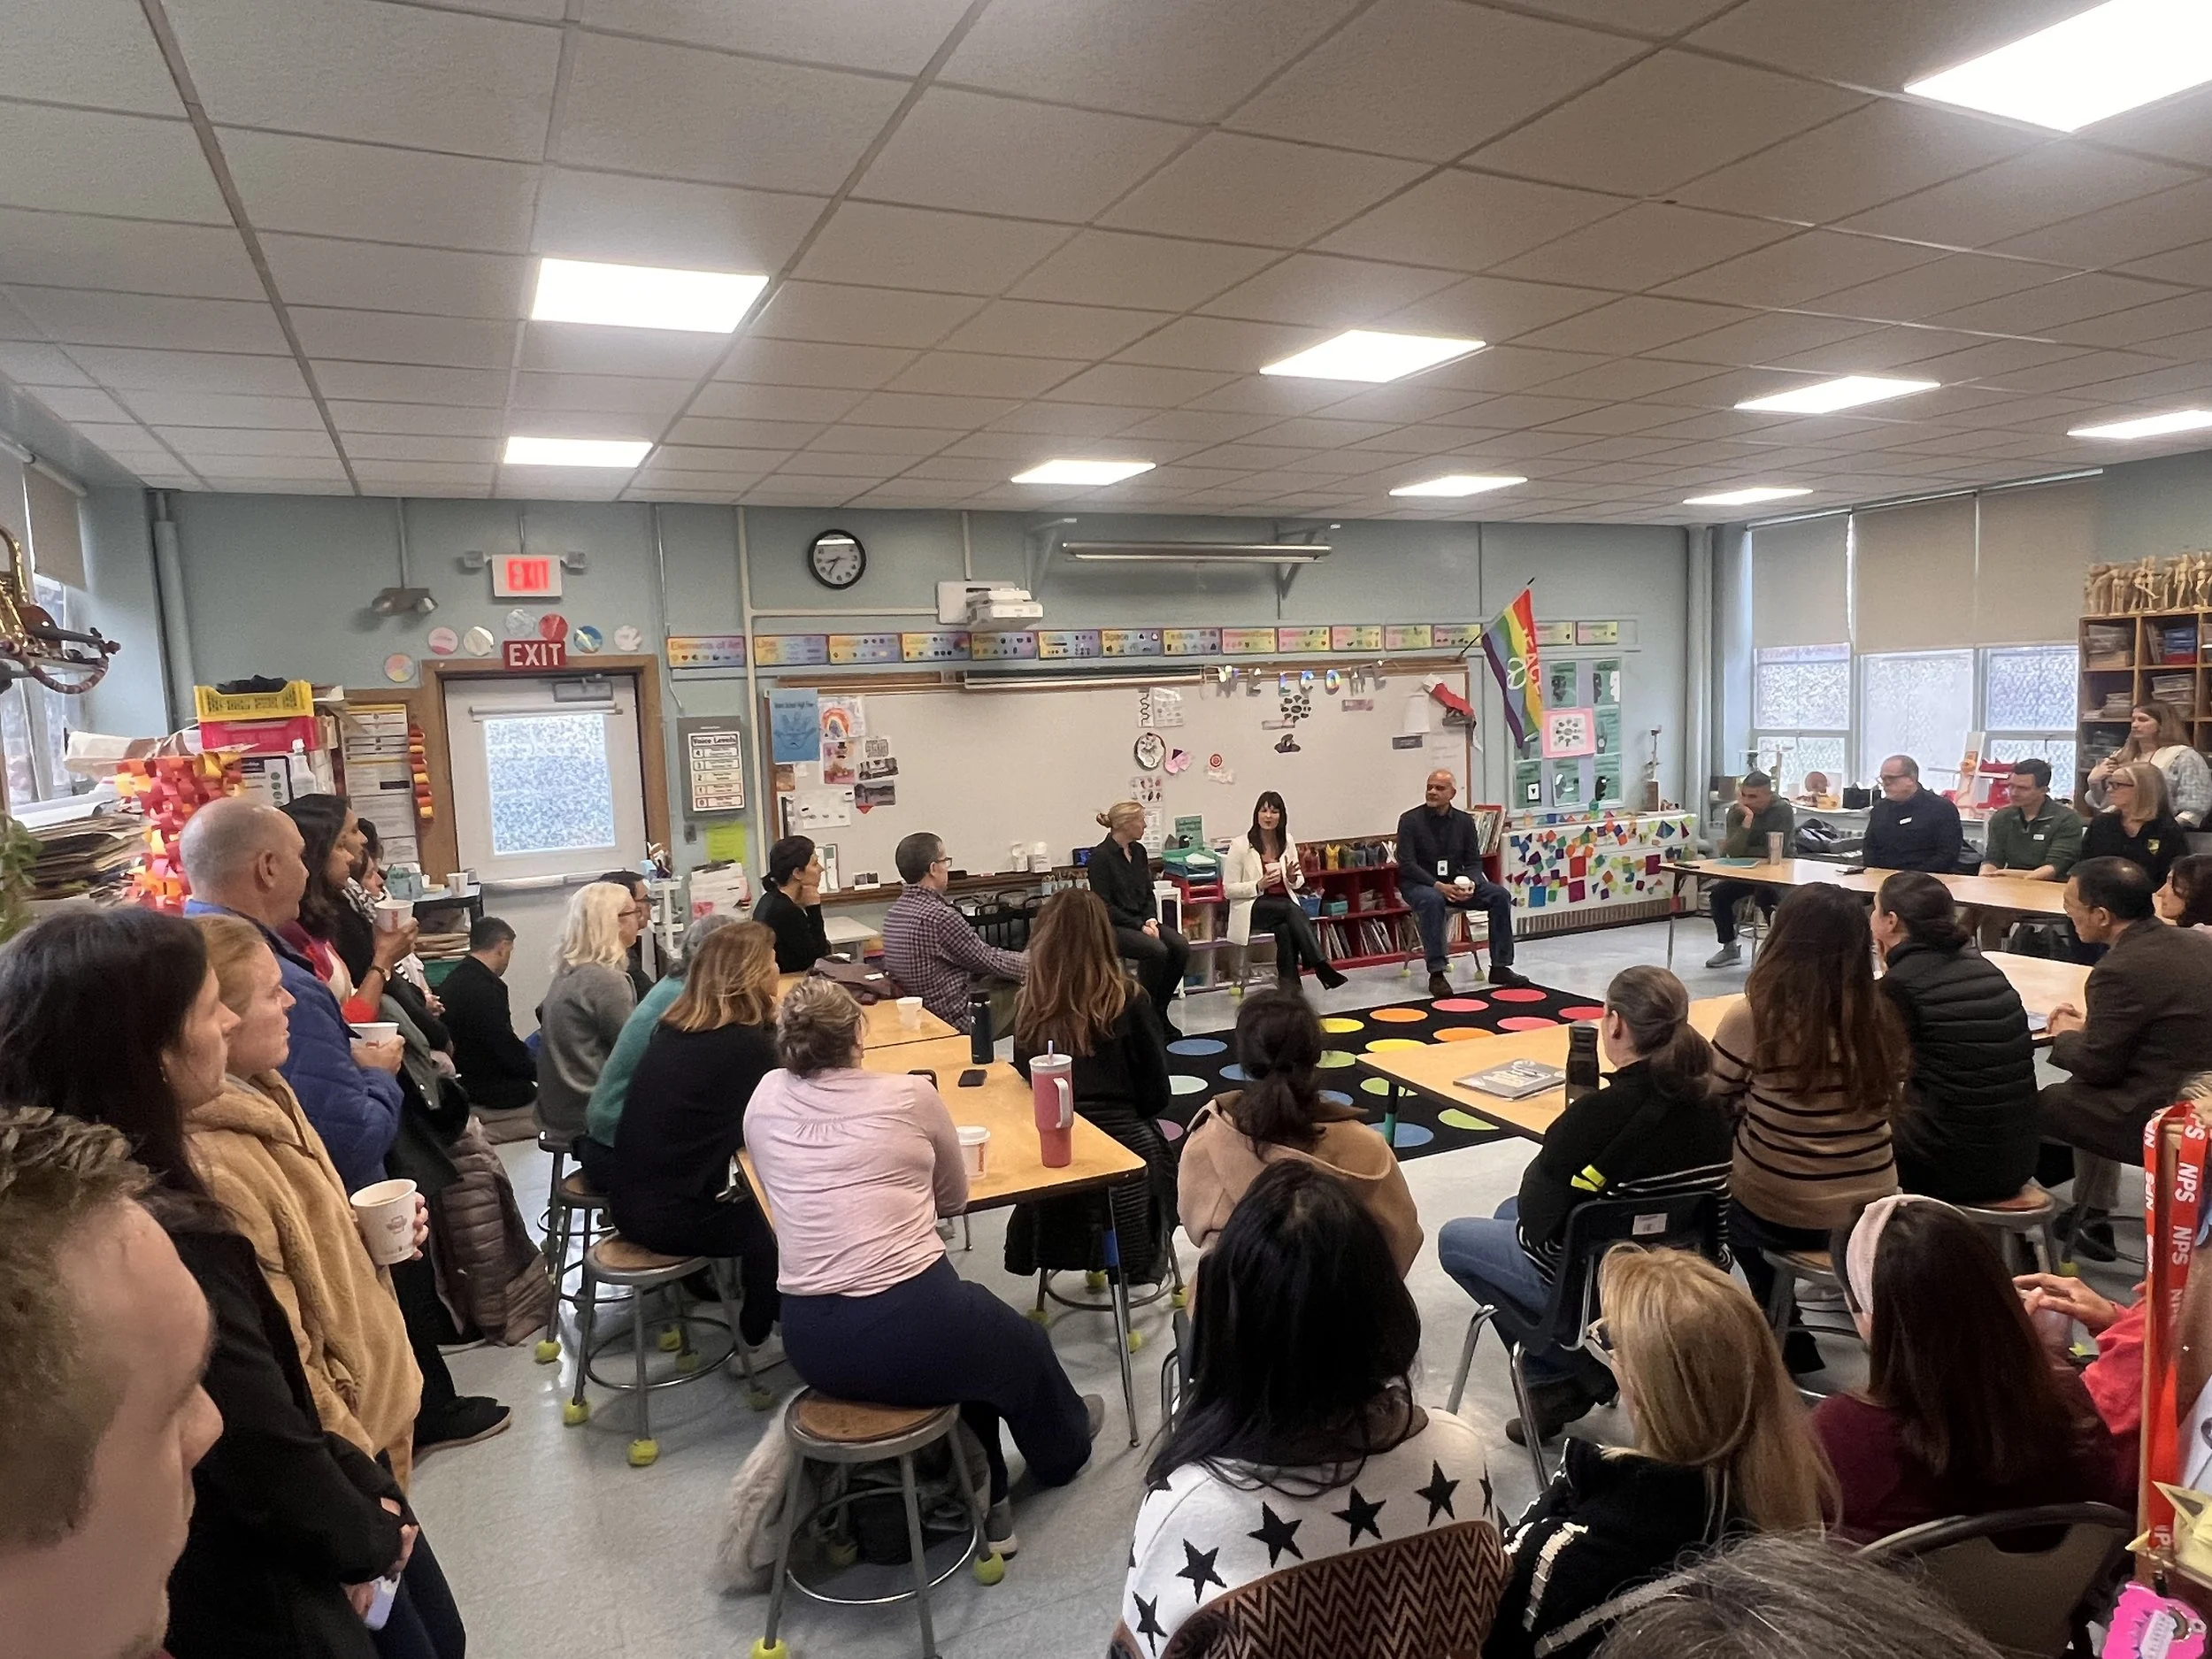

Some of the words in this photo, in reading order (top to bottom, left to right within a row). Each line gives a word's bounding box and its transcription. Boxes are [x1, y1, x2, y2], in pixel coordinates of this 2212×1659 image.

[509, 643, 562, 666] EXIT
[2145, 1171, 2156, 1211] NPS
[2175, 1162, 2199, 1203] NPS
[2171, 1225, 2193, 1266] NPS
